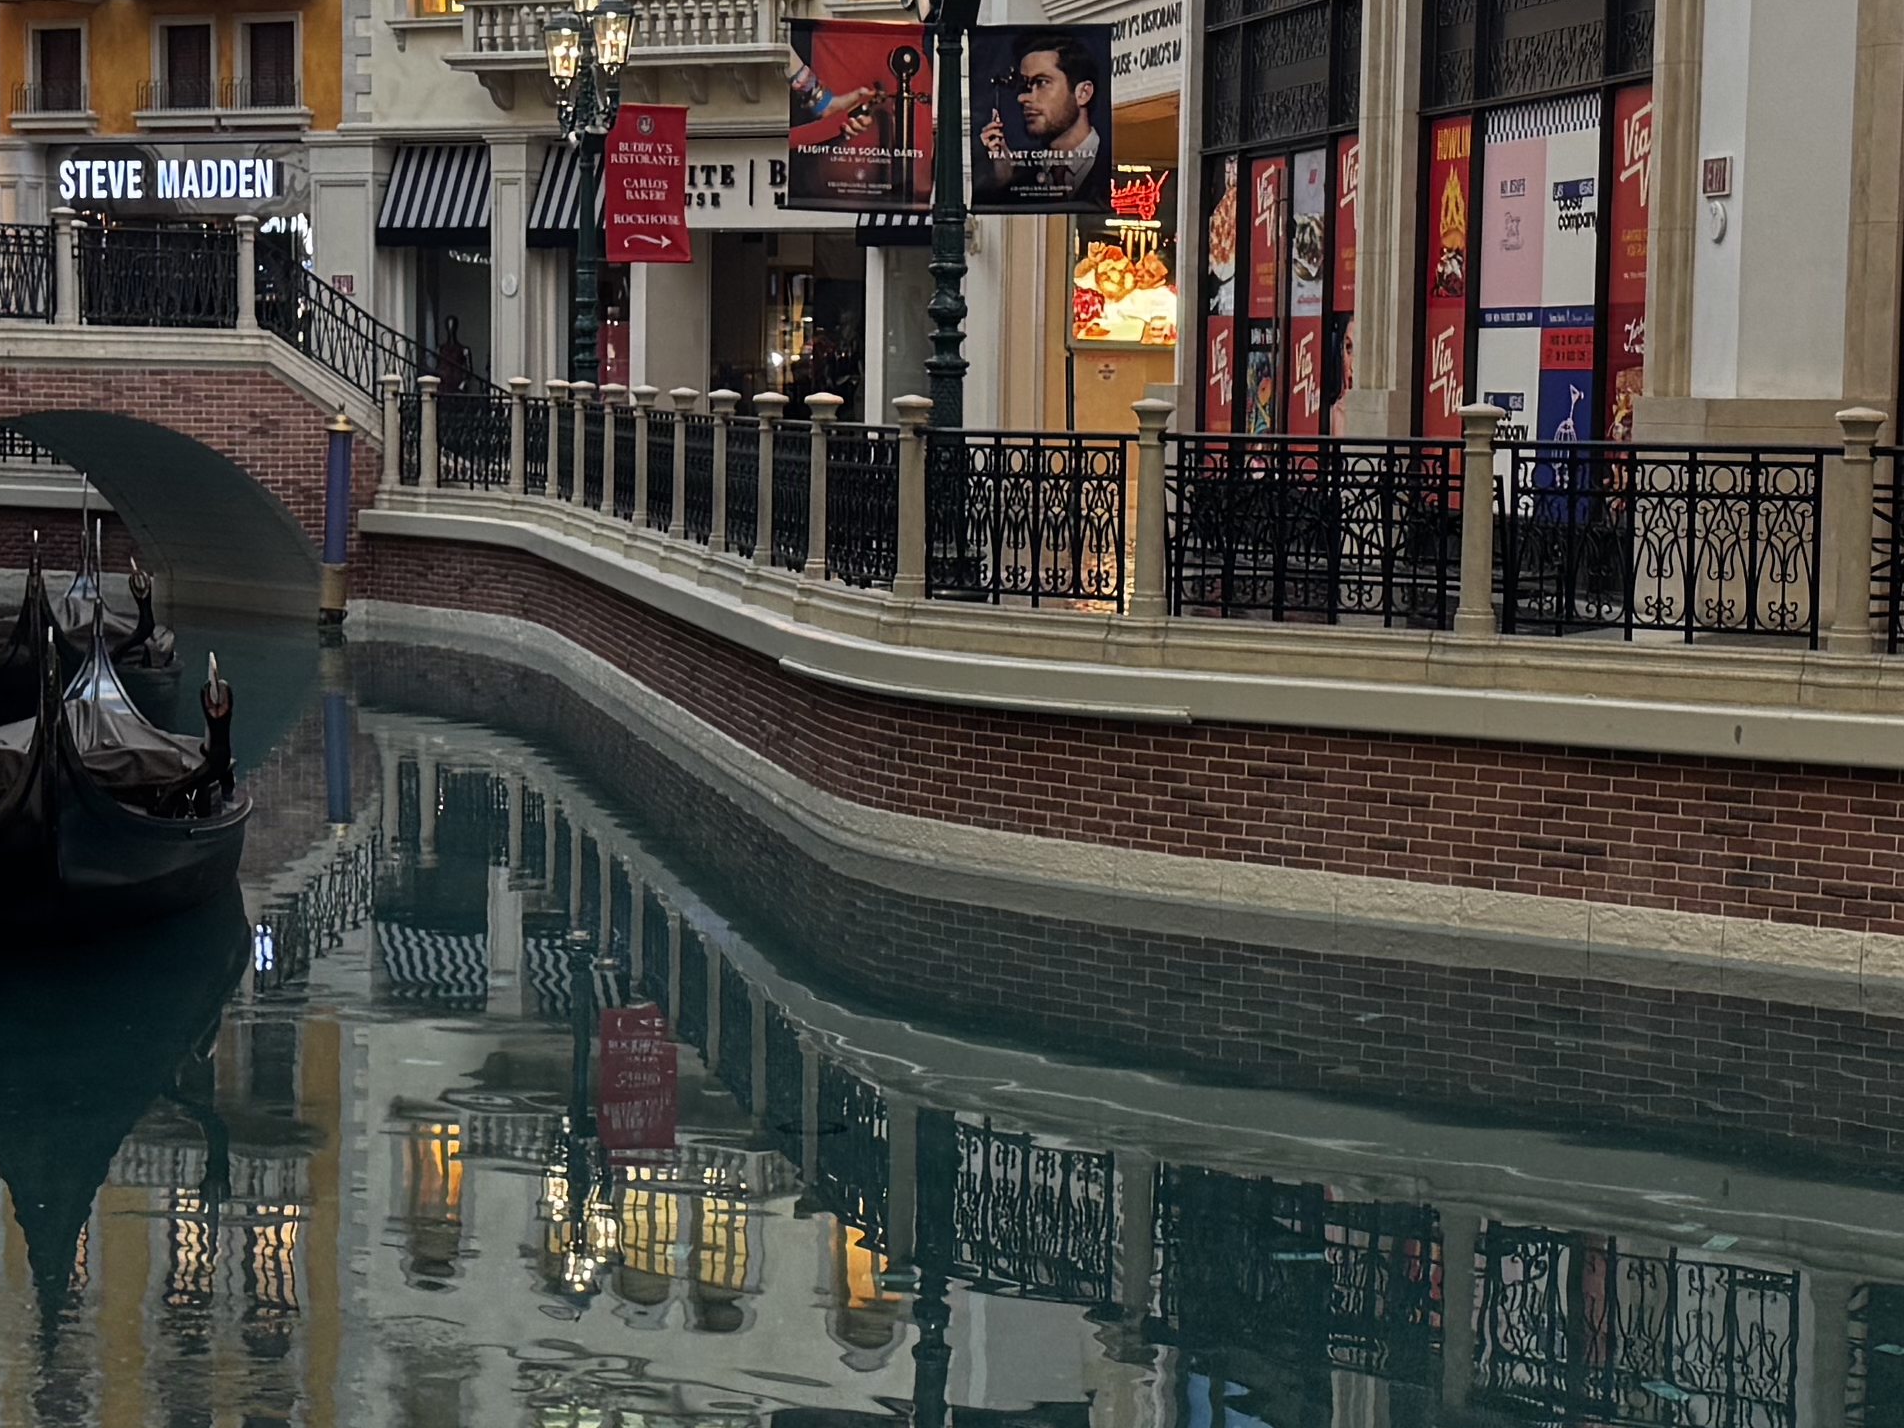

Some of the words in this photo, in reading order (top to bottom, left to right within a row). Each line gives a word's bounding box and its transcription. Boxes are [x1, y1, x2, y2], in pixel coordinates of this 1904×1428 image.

[797, 144, 830, 155] FLIGHT
[832, 146, 856, 156] CLUB
[858, 147, 892, 158] SOCIAL
[893, 148, 924, 159] DARTS
[610, 153, 681, 167] RISTORANTE
[59, 159, 143, 200] STEVE
[156, 158, 274, 199] MADDEN
[687, 164, 735, 188] ITE
[625, 189, 667, 202] BAKERY
[684, 192, 721, 209] USE
[613, 213, 681, 226] ROCKHOUSE
[1432, 324, 1455, 380] Via
